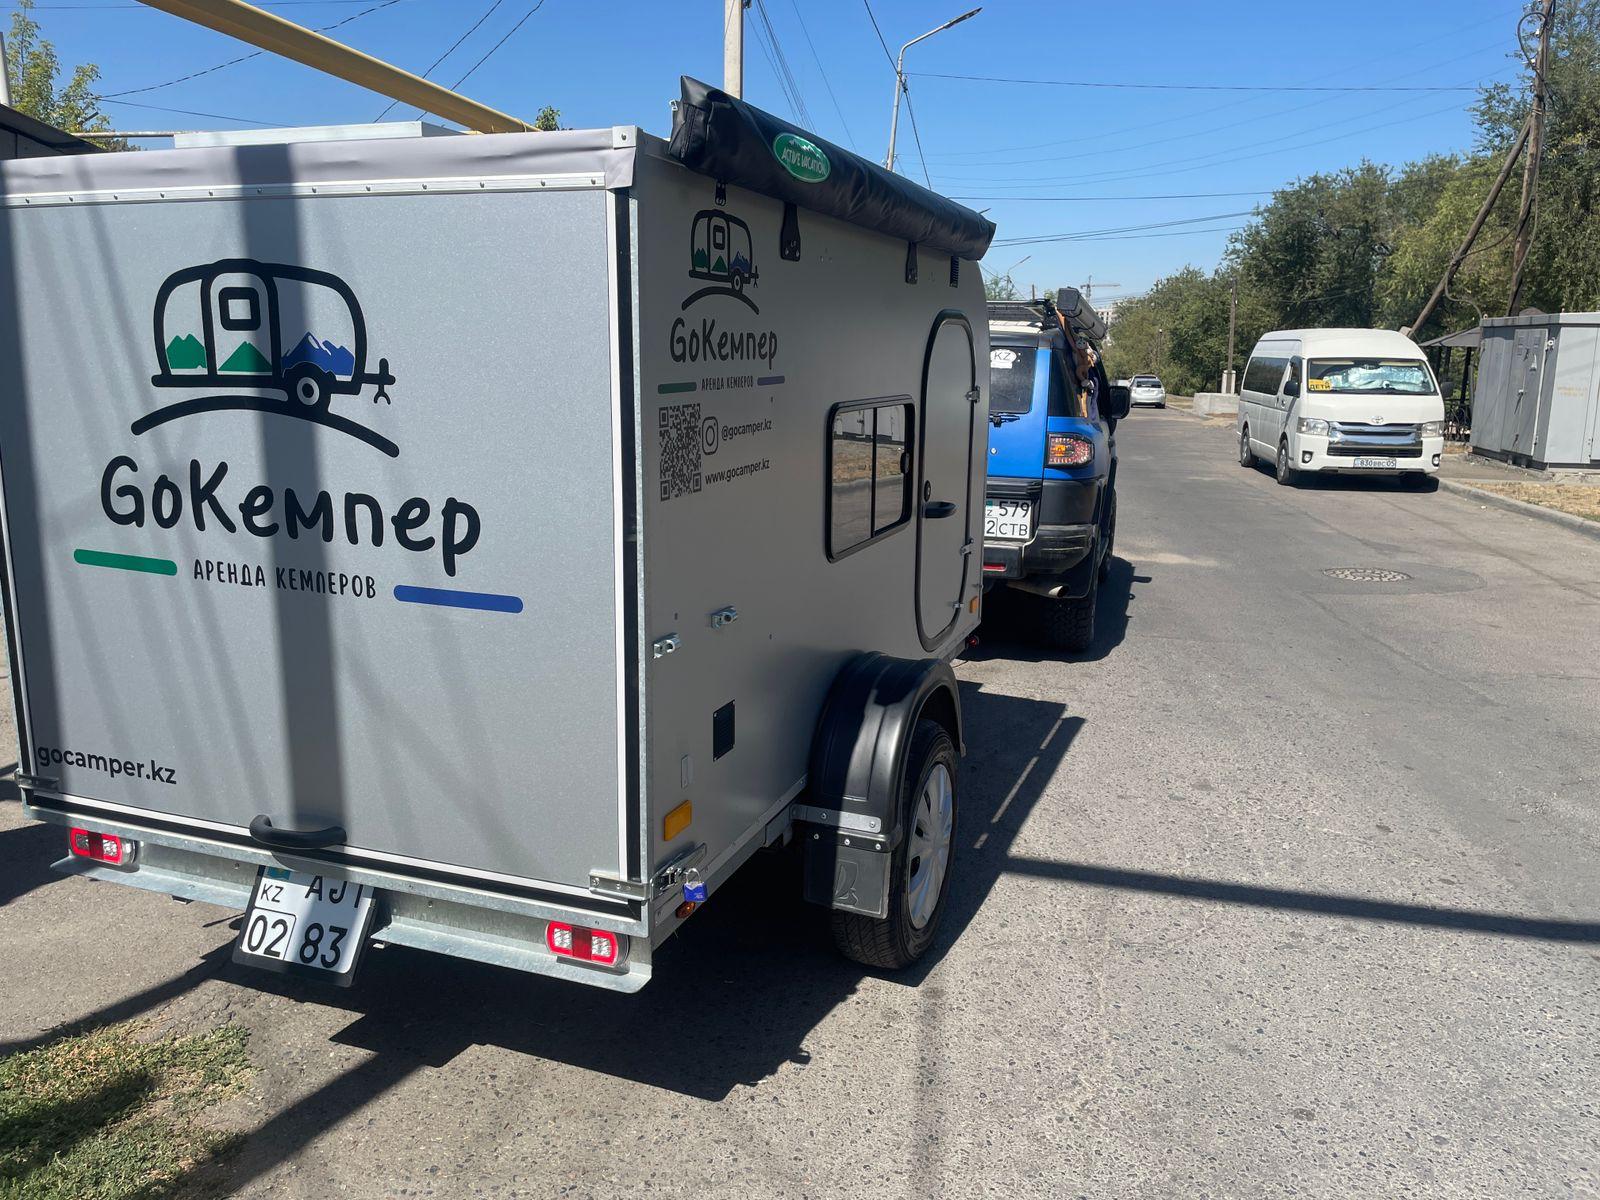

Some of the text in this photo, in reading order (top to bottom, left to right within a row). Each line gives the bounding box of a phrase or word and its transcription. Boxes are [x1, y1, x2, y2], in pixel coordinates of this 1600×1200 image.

[781, 147, 801, 166] ACTIVE
[994, 352, 1011, 360] KZ
[701, 375, 754, 391] АРЕНДА КЕМПЕРОВ
[721, 418, 772, 441] @gocamper.kz
[705, 458, 770, 484] www.gocamper.kz
[999, 501, 1030, 518] 579
[986, 520, 1028, 536] 2 CTB
[193, 559, 377, 599] АРЕНДА КЕМПЕРОВ
[37, 746, 177, 785] gocamper.kz
[261, 884, 284, 903] KZ
[247, 915, 348, 968] 02 83
